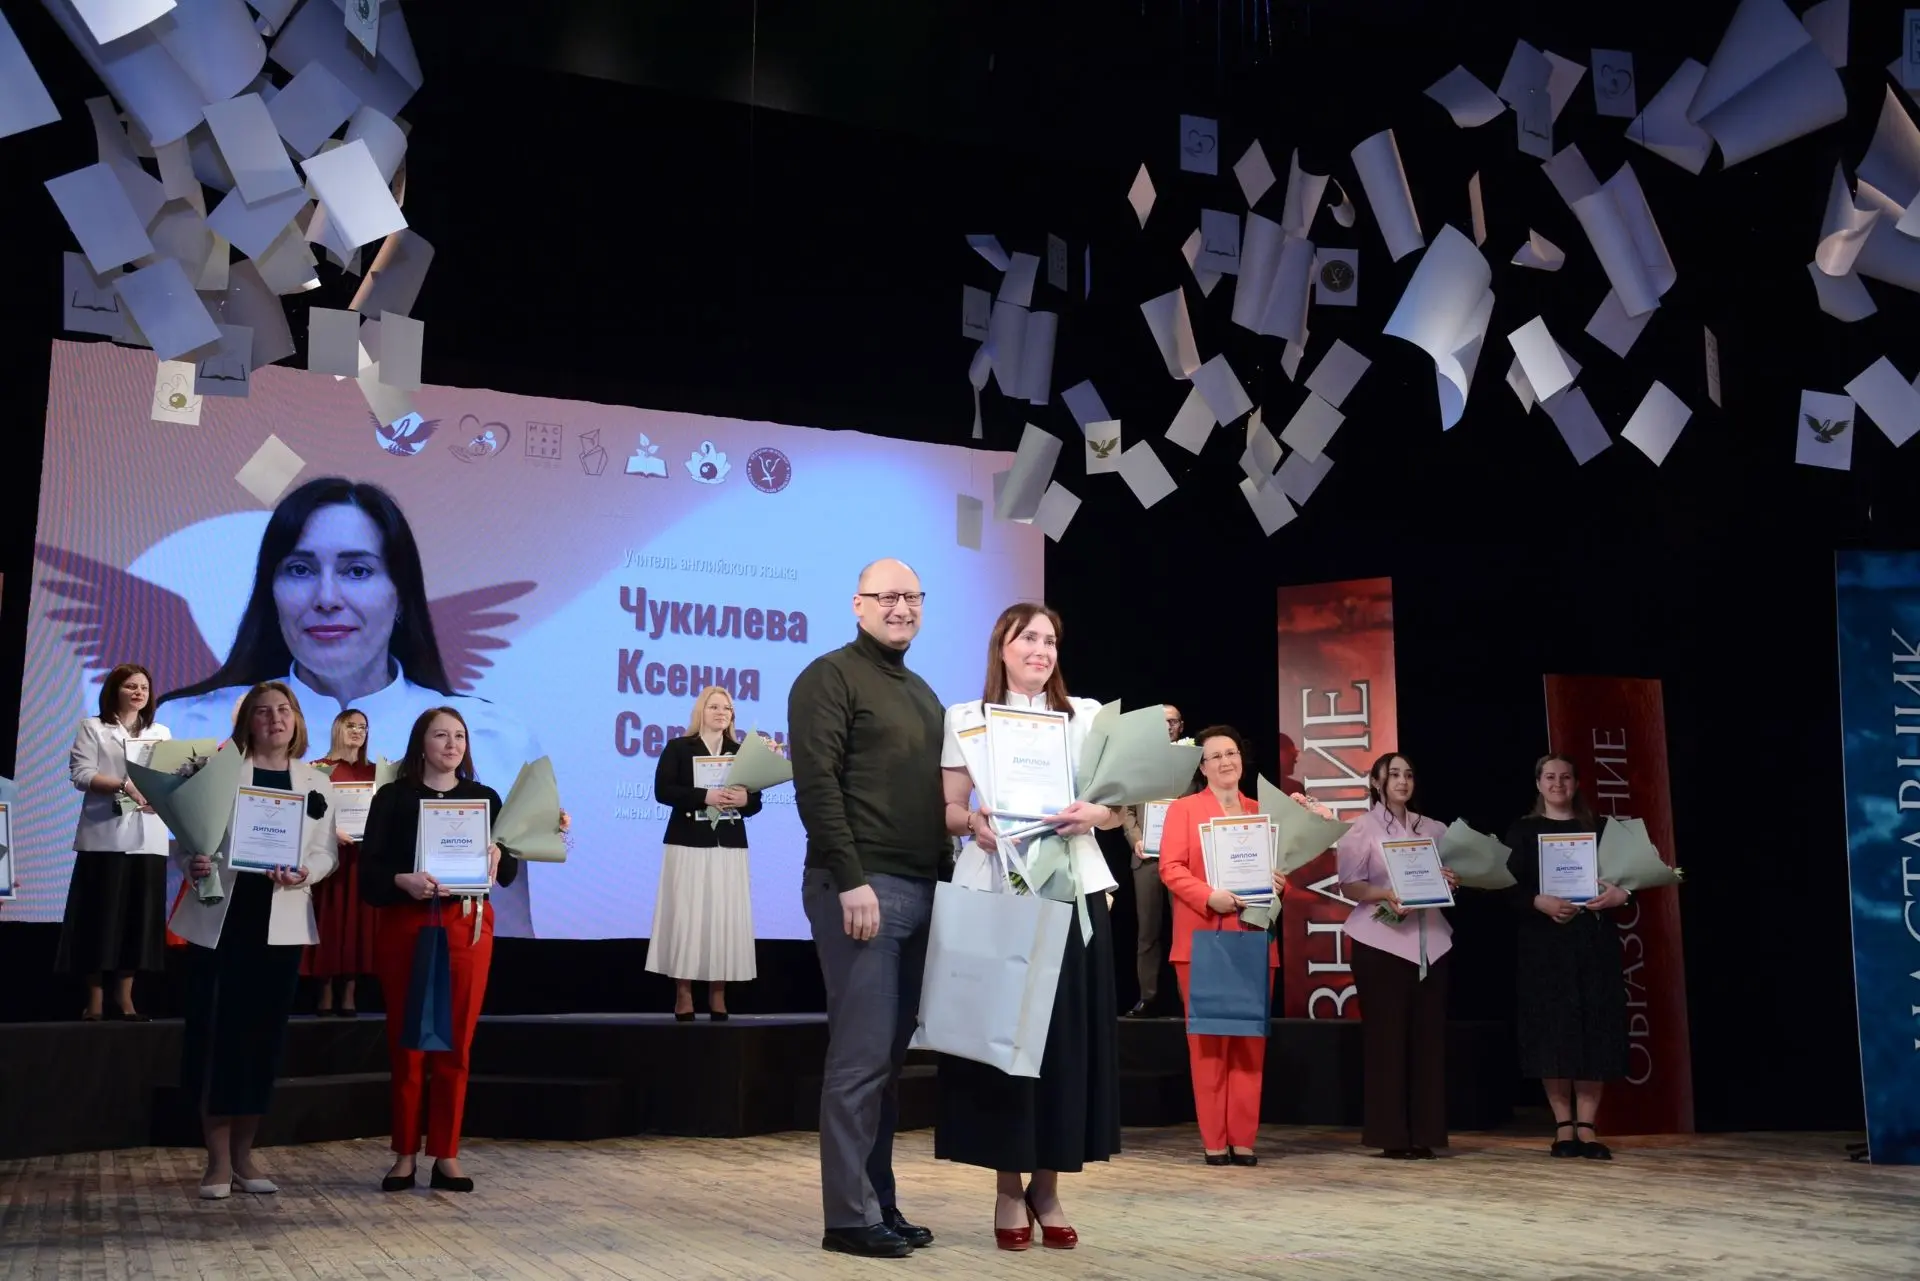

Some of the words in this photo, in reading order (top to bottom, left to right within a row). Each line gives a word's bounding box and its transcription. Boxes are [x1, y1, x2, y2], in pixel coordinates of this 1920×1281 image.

[624, 549, 677, 570] Учитель
[679, 556, 757, 577] английского
[759, 564, 798, 581] языка
[619, 585, 808, 644] Чукилева
[617, 648, 760, 701] Ксения
[1012, 756, 1050, 766] ДИПЛОМ
[615, 806, 652, 821] имени
[252, 825, 286, 834] ДИПЛОМ
[1230, 852, 1258, 860] ДИПЛОМ
